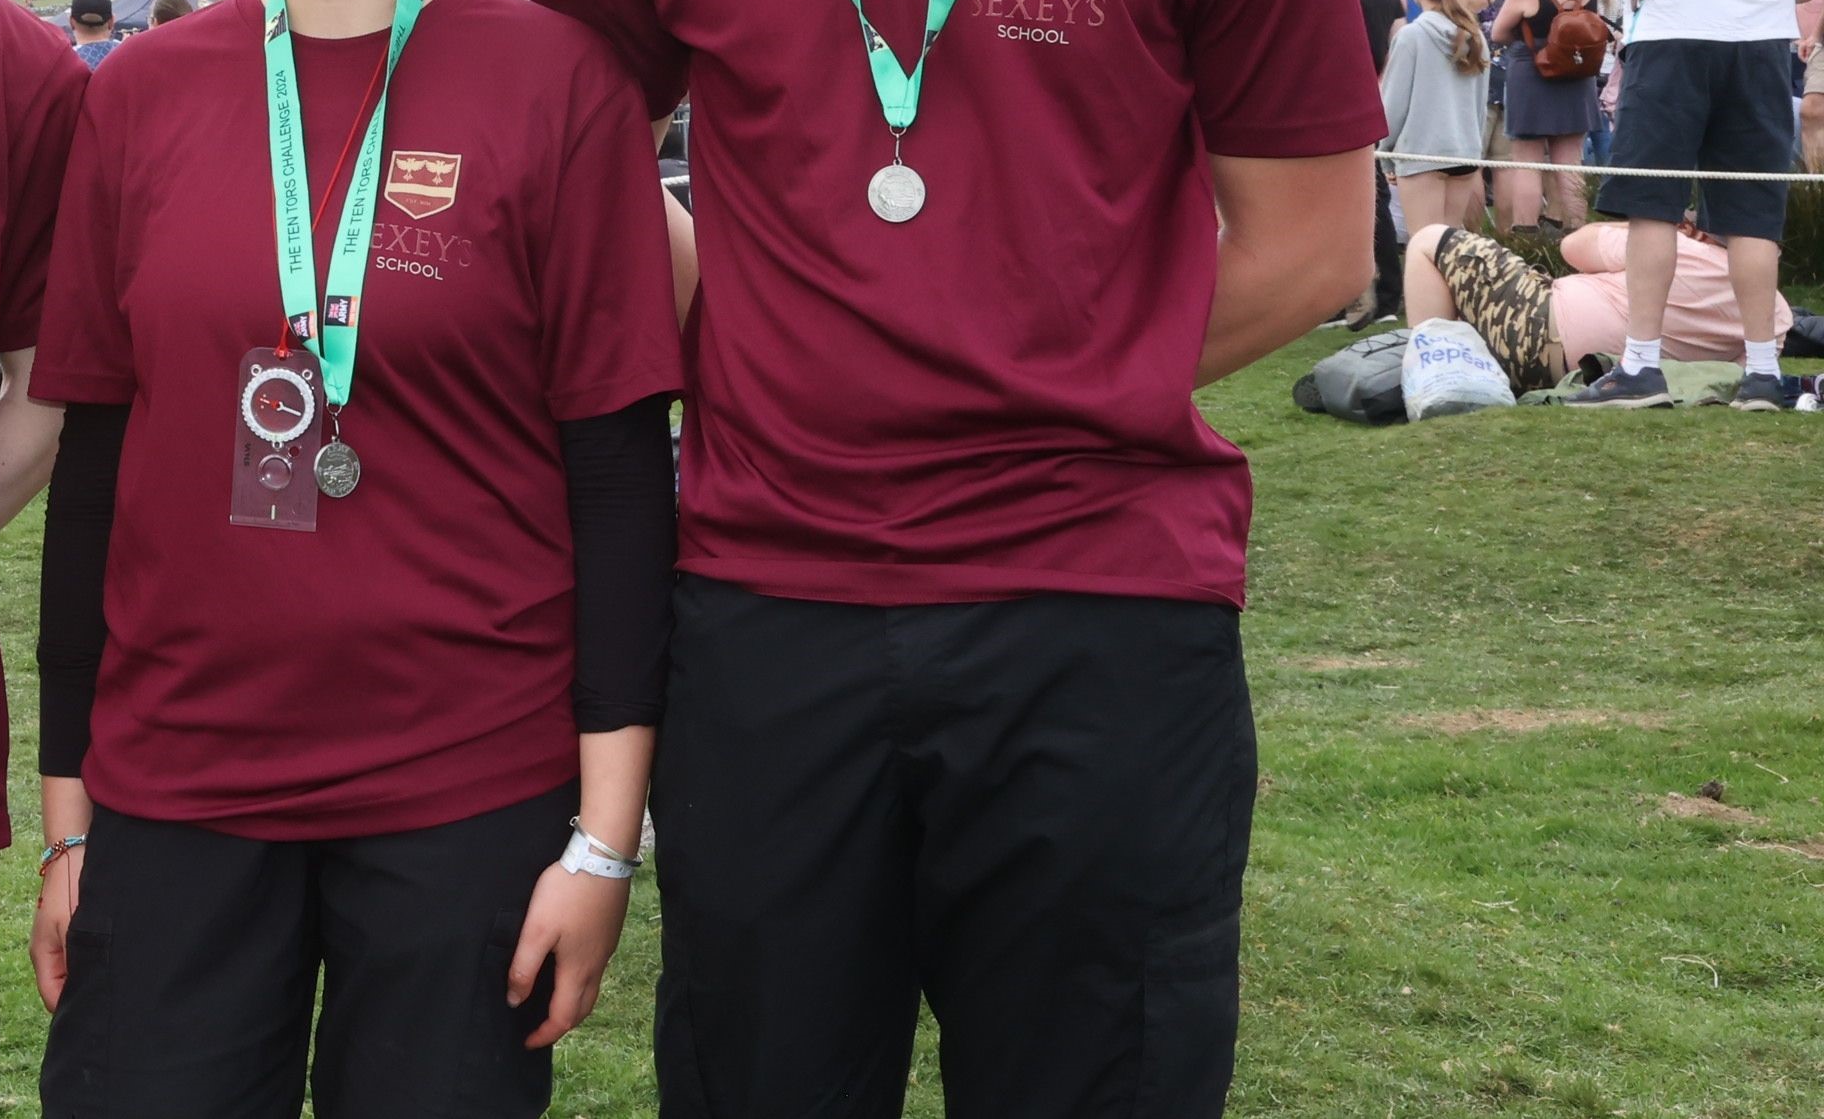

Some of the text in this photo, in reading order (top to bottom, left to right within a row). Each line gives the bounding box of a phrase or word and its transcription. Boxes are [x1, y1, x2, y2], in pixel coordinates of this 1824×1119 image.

[997, 24, 1070, 45] SCHOOL
[276, 70, 302, 274] THE TEN TORS CHALLENGE 2024
[357, 157, 373, 195] TORS
[350, 197, 365, 225] TEN
[343, 228, 360, 255] THE
[370, 223, 473, 267] EXEY'S
[376, 256, 444, 280] SCHOOL
[338, 298, 349, 323] ARMY
